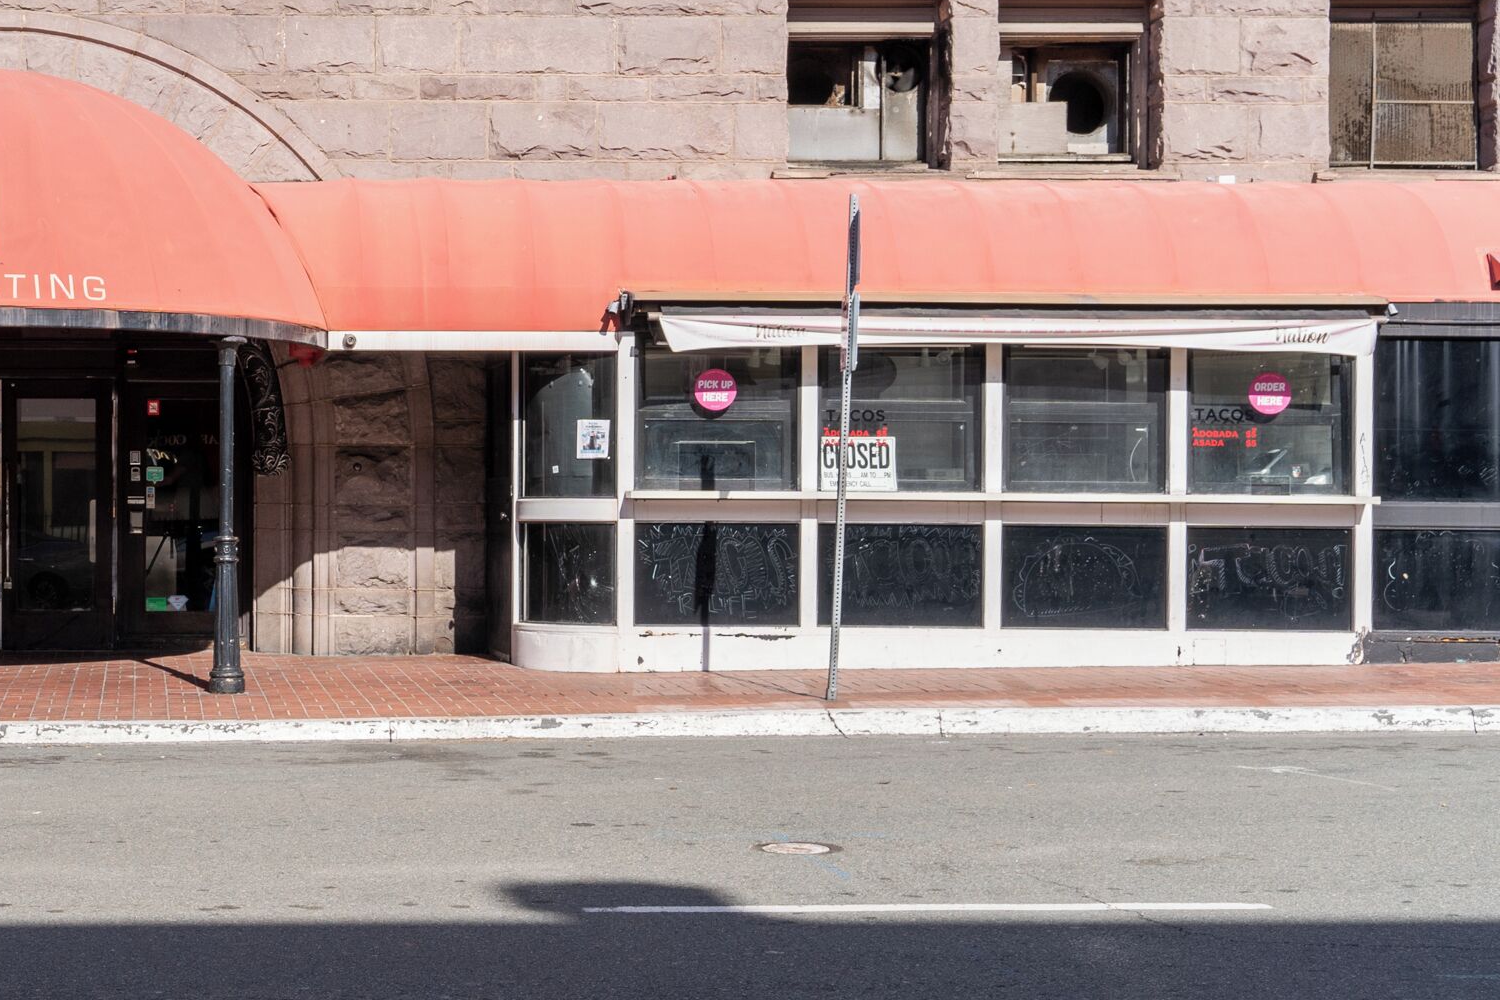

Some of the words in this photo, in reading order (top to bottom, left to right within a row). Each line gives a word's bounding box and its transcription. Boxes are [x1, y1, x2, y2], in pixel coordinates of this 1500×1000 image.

[698, 380, 719, 389] PICK
[721, 380, 734, 389] UP
[1254, 382, 1286, 392] ORDER
[702, 391, 729, 402] HERE
[1256, 395, 1284, 406] HERE
[826, 409, 885, 422] TCOS
[1194, 408, 1255, 421] TACOS
[824, 429, 869, 437] ADOADA
[1192, 429, 1239, 438] ADOBADA
[1192, 439, 1225, 447] ASADA
[822, 442, 890, 469] CLOSED
